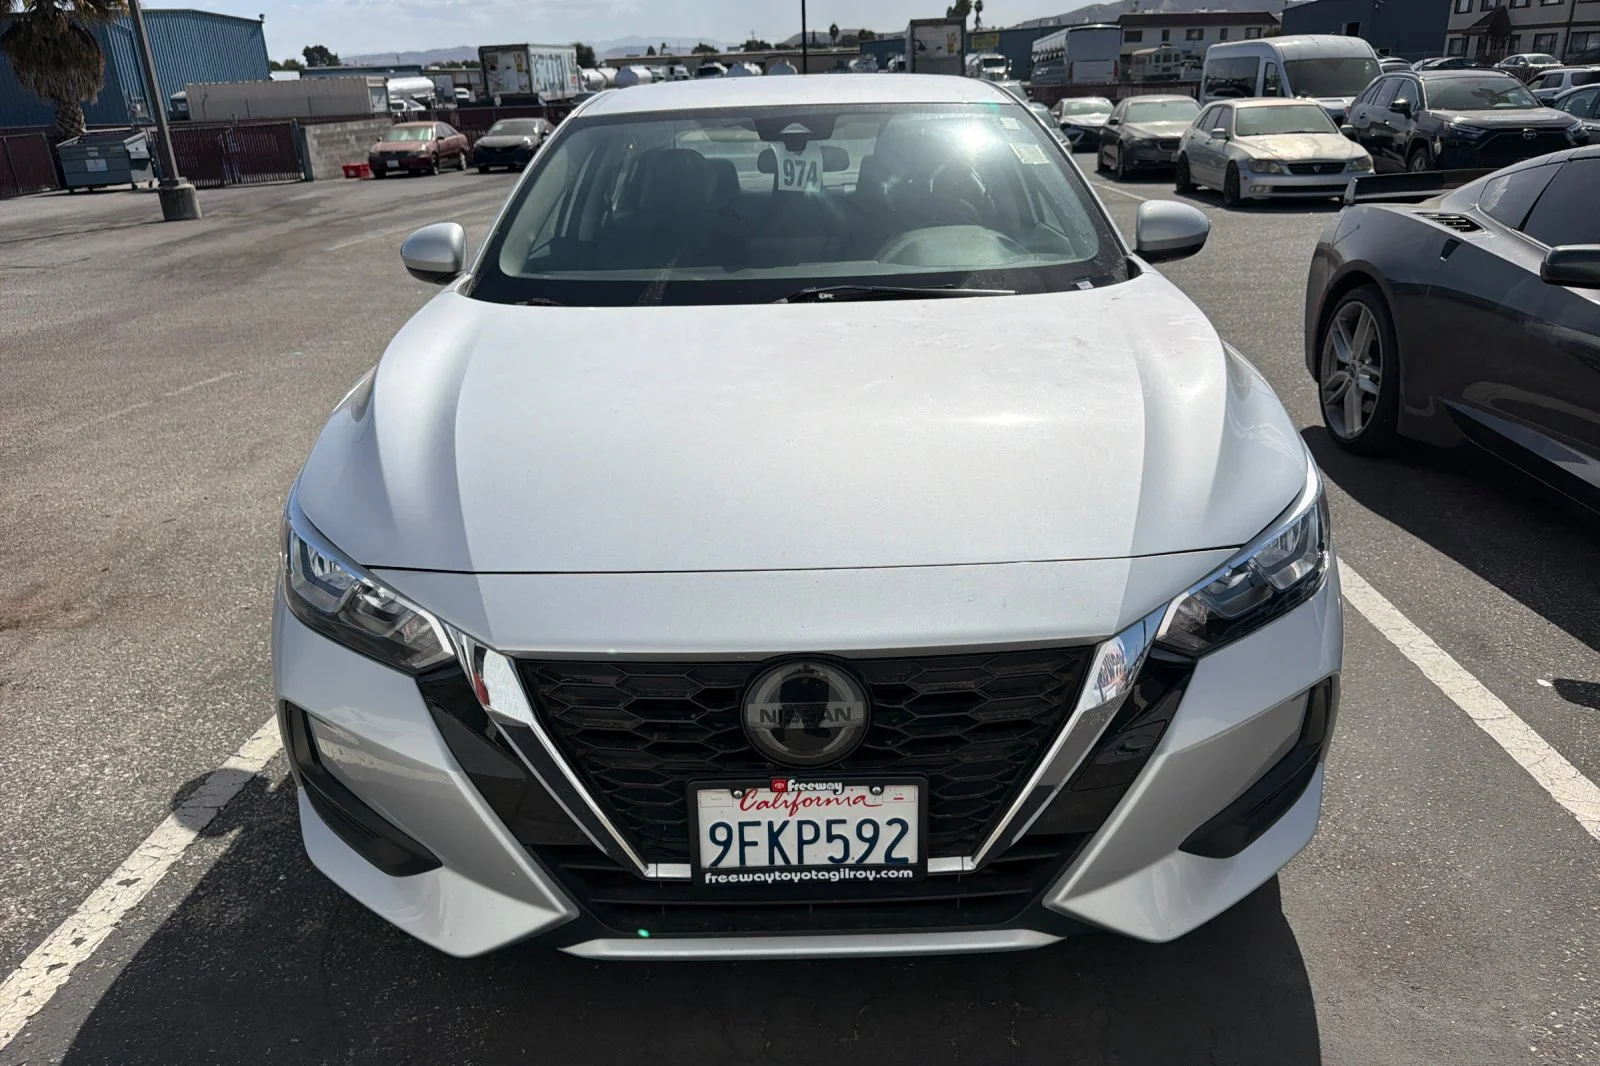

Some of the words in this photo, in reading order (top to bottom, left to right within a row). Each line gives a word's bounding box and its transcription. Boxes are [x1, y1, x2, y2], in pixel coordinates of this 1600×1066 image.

[782, 158, 818, 187] 974
[759, 707, 852, 723] NIAN
[709, 817, 910, 868] 9FKP592
[705, 868, 914, 884] freewaytoyotagilroy.com
